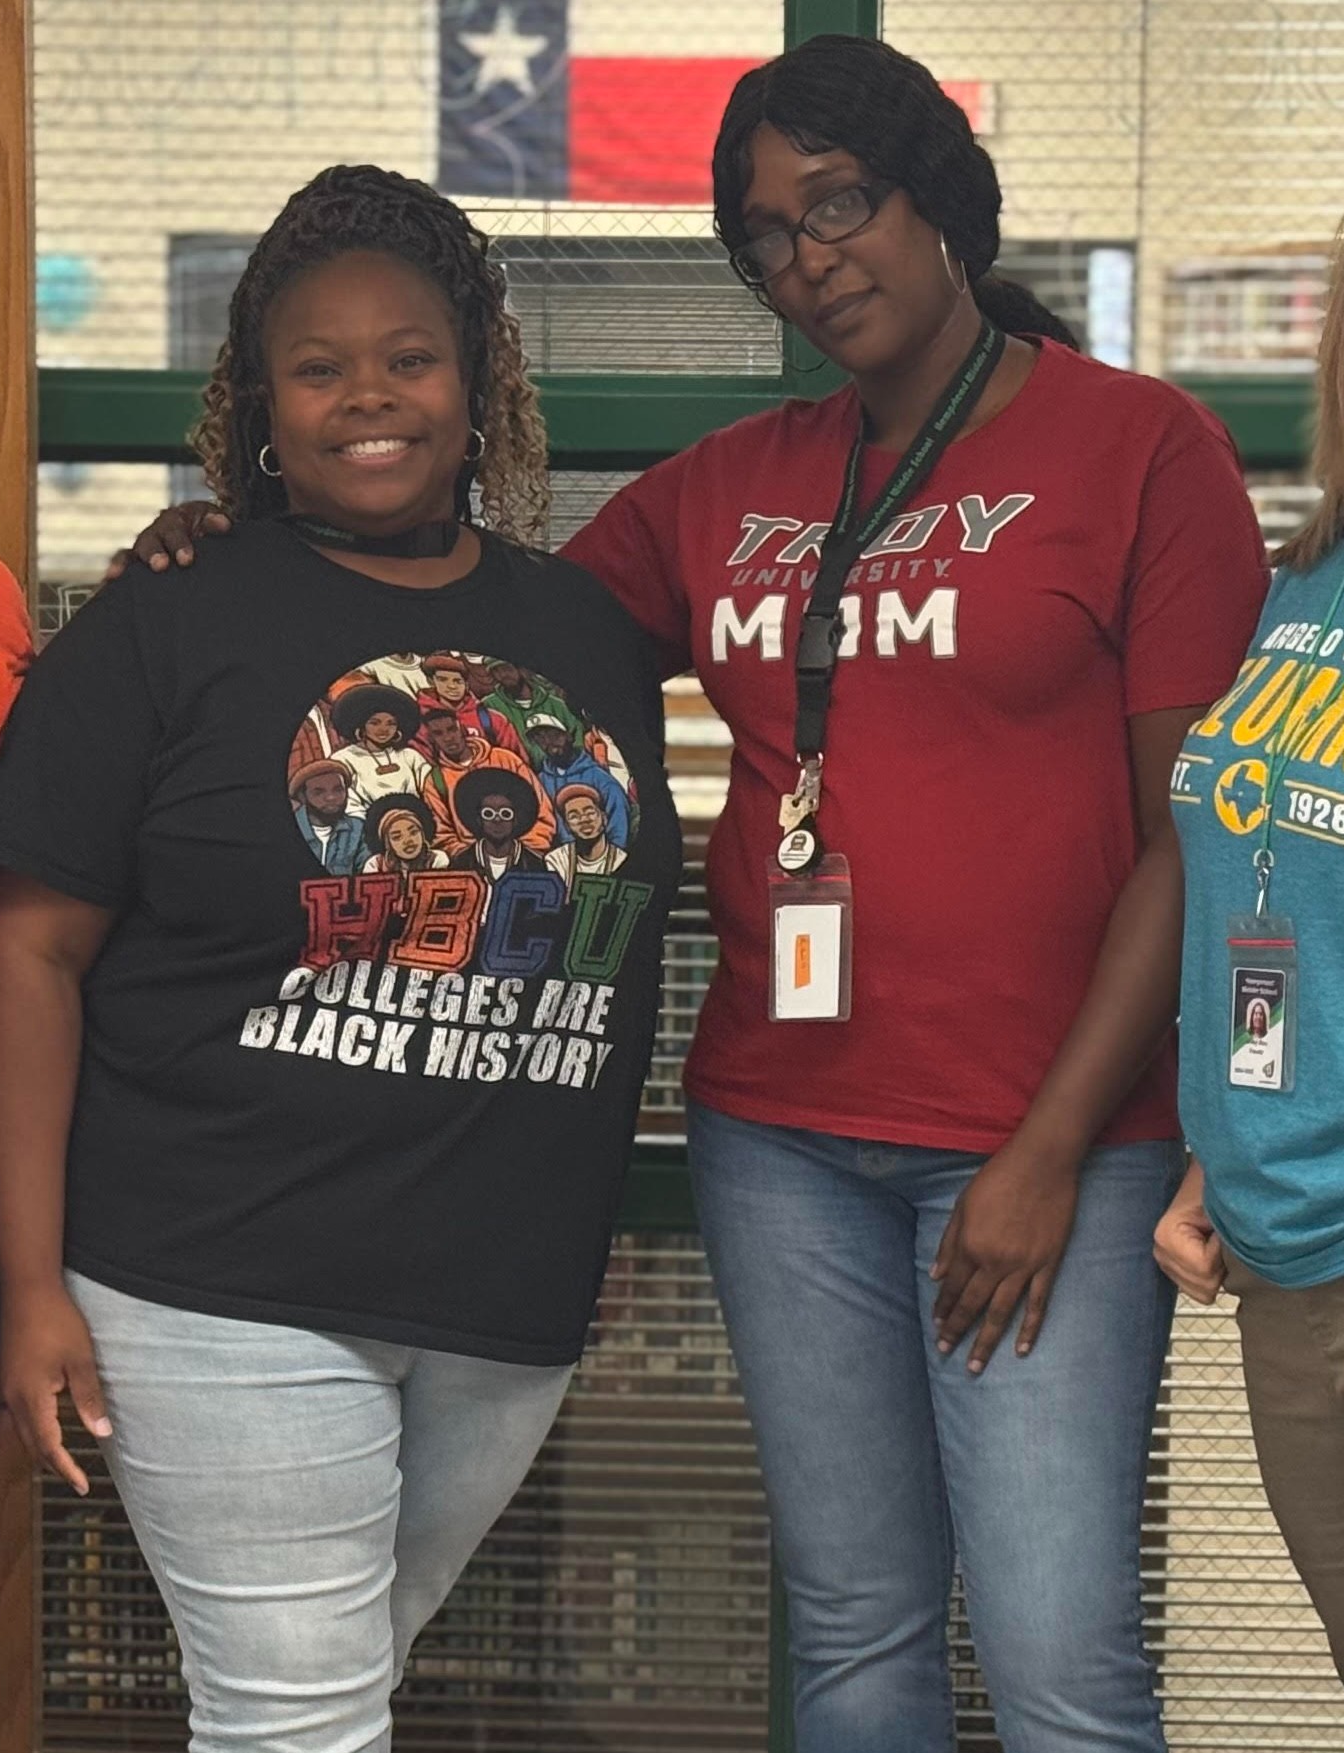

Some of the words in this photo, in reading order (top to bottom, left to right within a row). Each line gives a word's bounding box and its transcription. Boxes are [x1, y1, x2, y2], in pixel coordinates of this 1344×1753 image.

[732, 558, 953, 591] UNIVRSITY
[299, 871, 654, 982] HBCU
[278, 959, 524, 1029] COLLEGES
[532, 978, 616, 1036] ARE
[238, 1005, 417, 1075] BLACK
[422, 1026, 616, 1091] HISTORY
